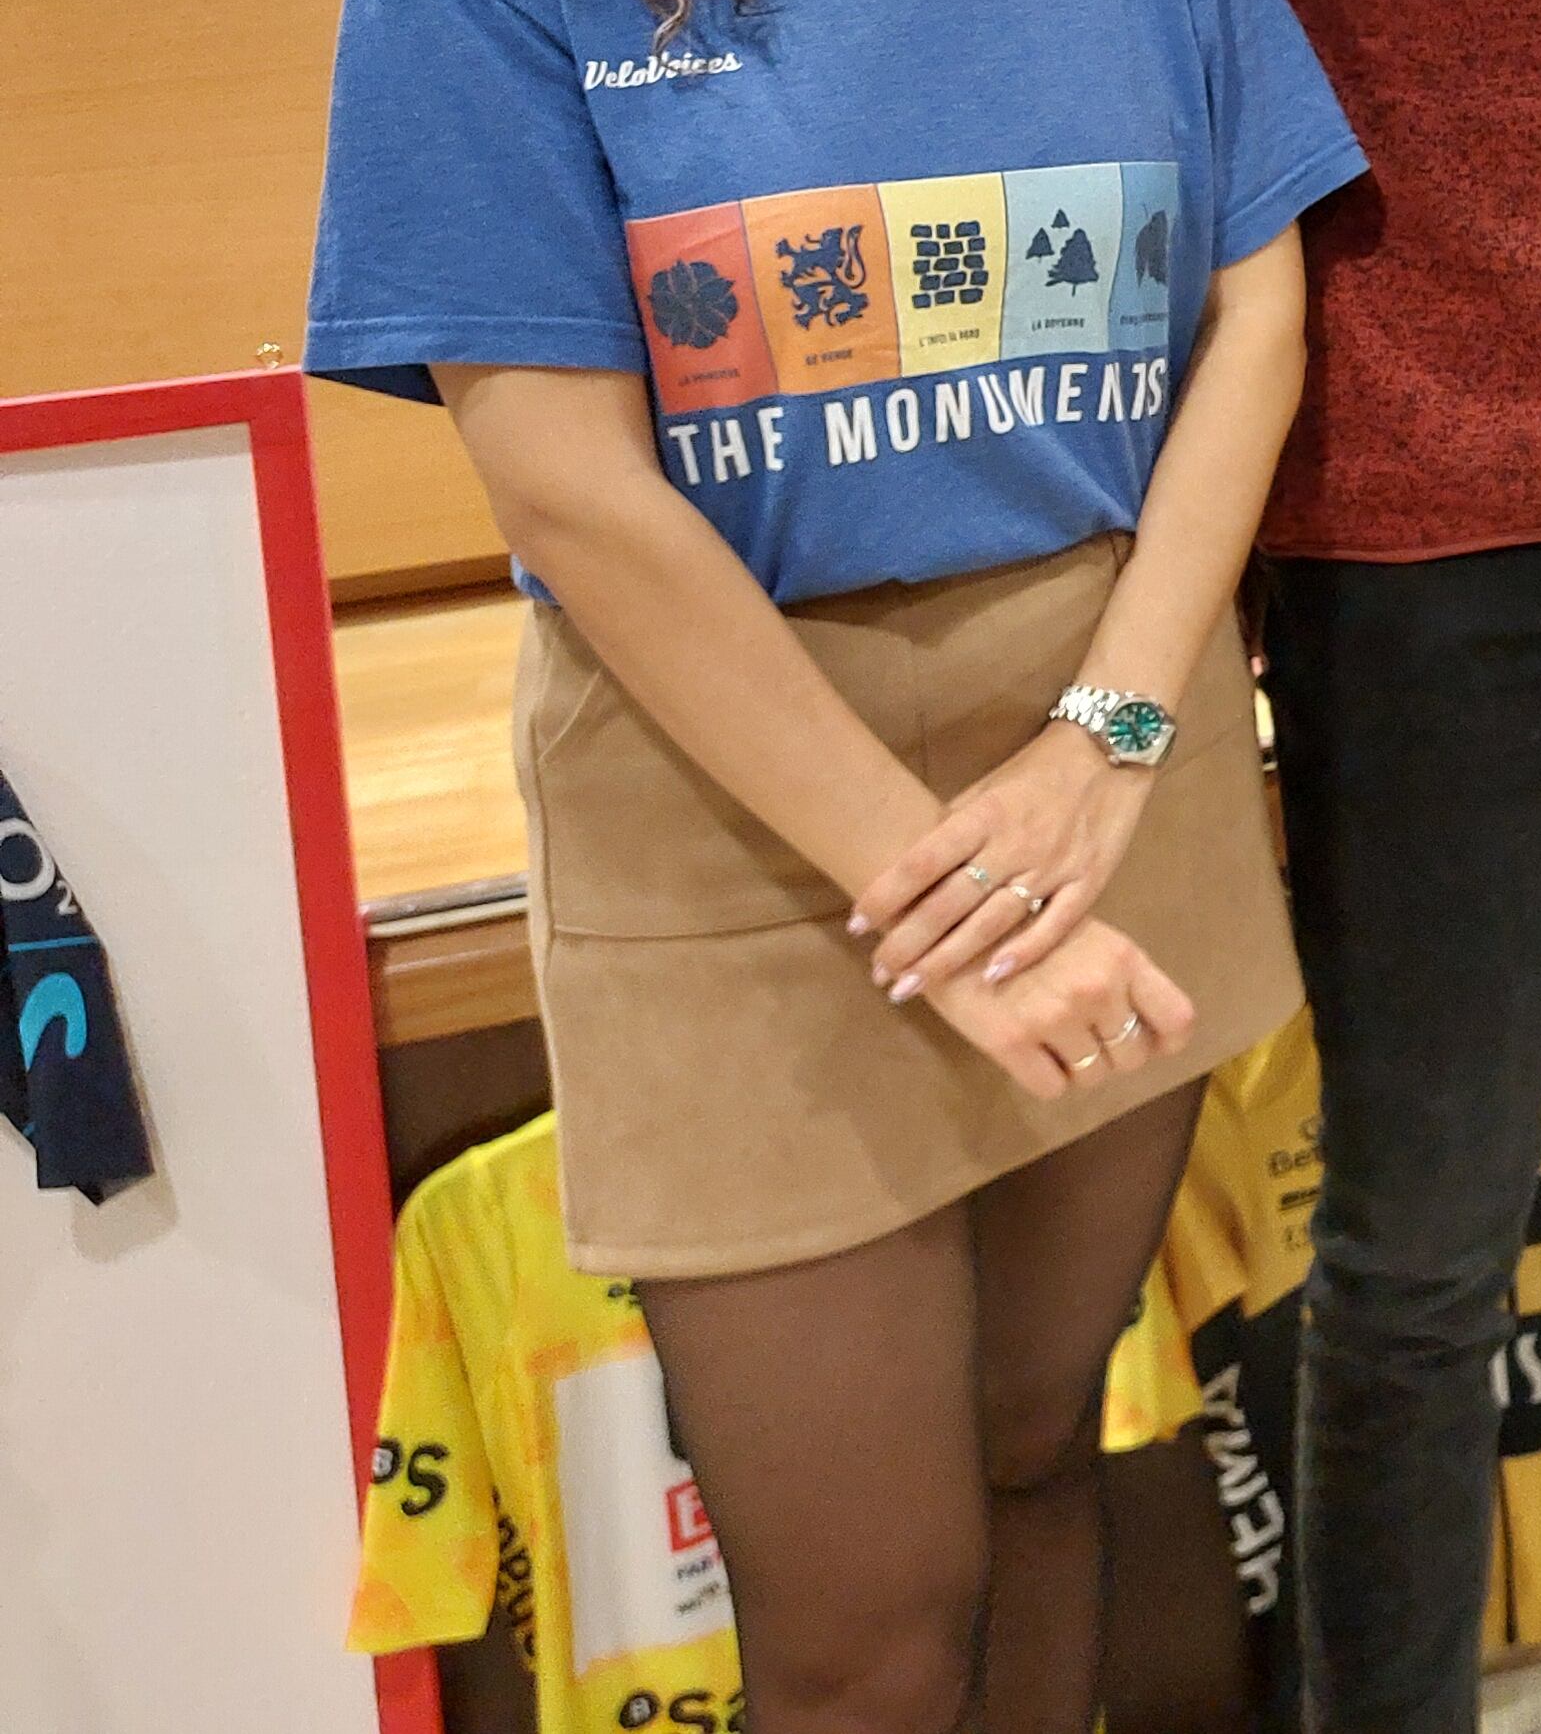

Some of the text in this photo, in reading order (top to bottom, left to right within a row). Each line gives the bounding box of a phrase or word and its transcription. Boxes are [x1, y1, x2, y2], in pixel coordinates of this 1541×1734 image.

[584, 51, 744, 91] VeloVoices
[667, 358, 1167, 485] THE MONUMENTS
